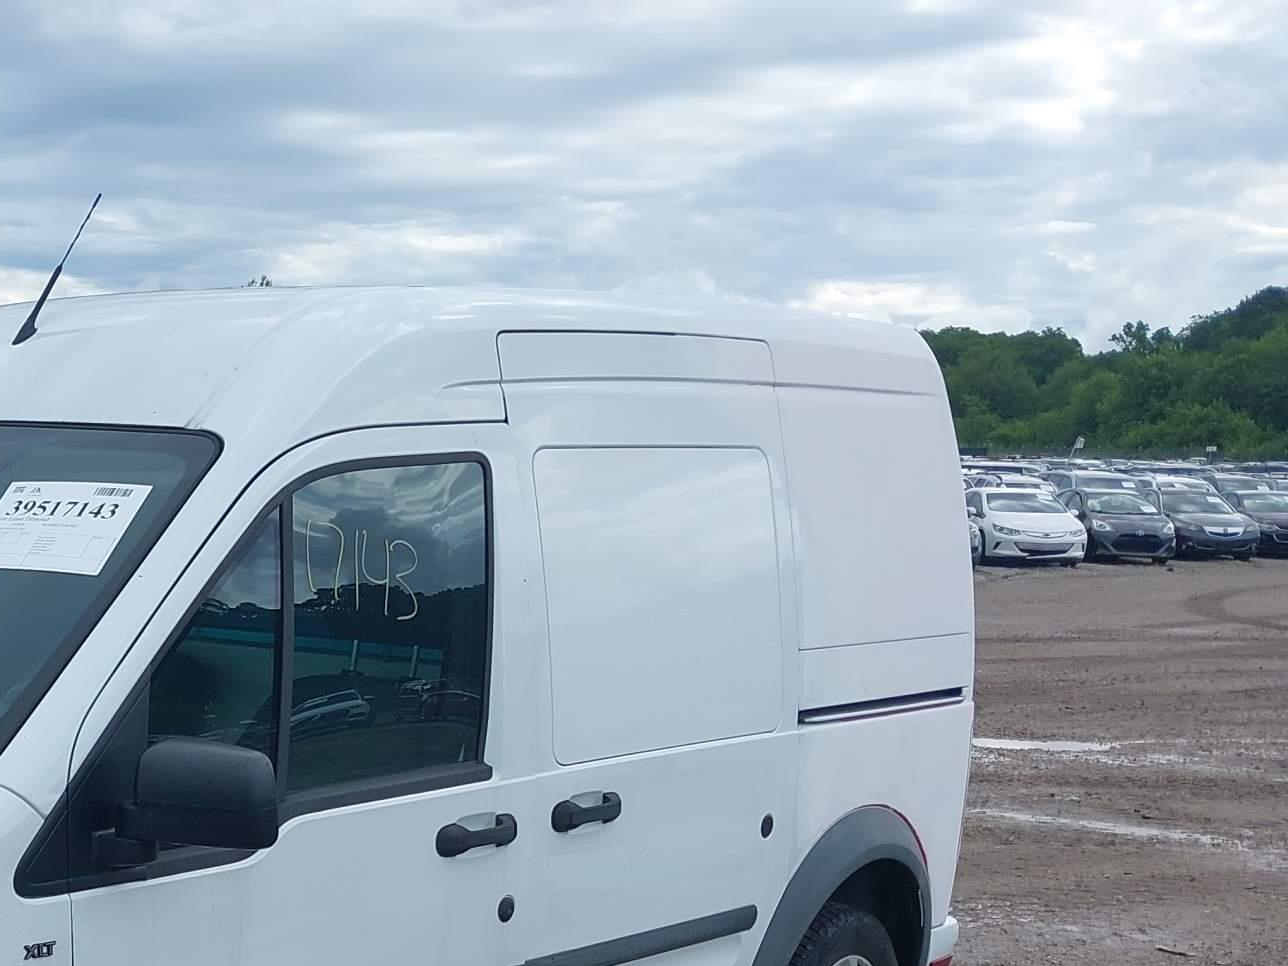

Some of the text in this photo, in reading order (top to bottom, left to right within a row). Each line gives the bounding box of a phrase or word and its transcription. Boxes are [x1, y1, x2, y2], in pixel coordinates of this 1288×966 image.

[5, 500, 119, 519] 39517143
[307, 519, 418, 620] 17143
[23, 940, 57, 961] XLT
